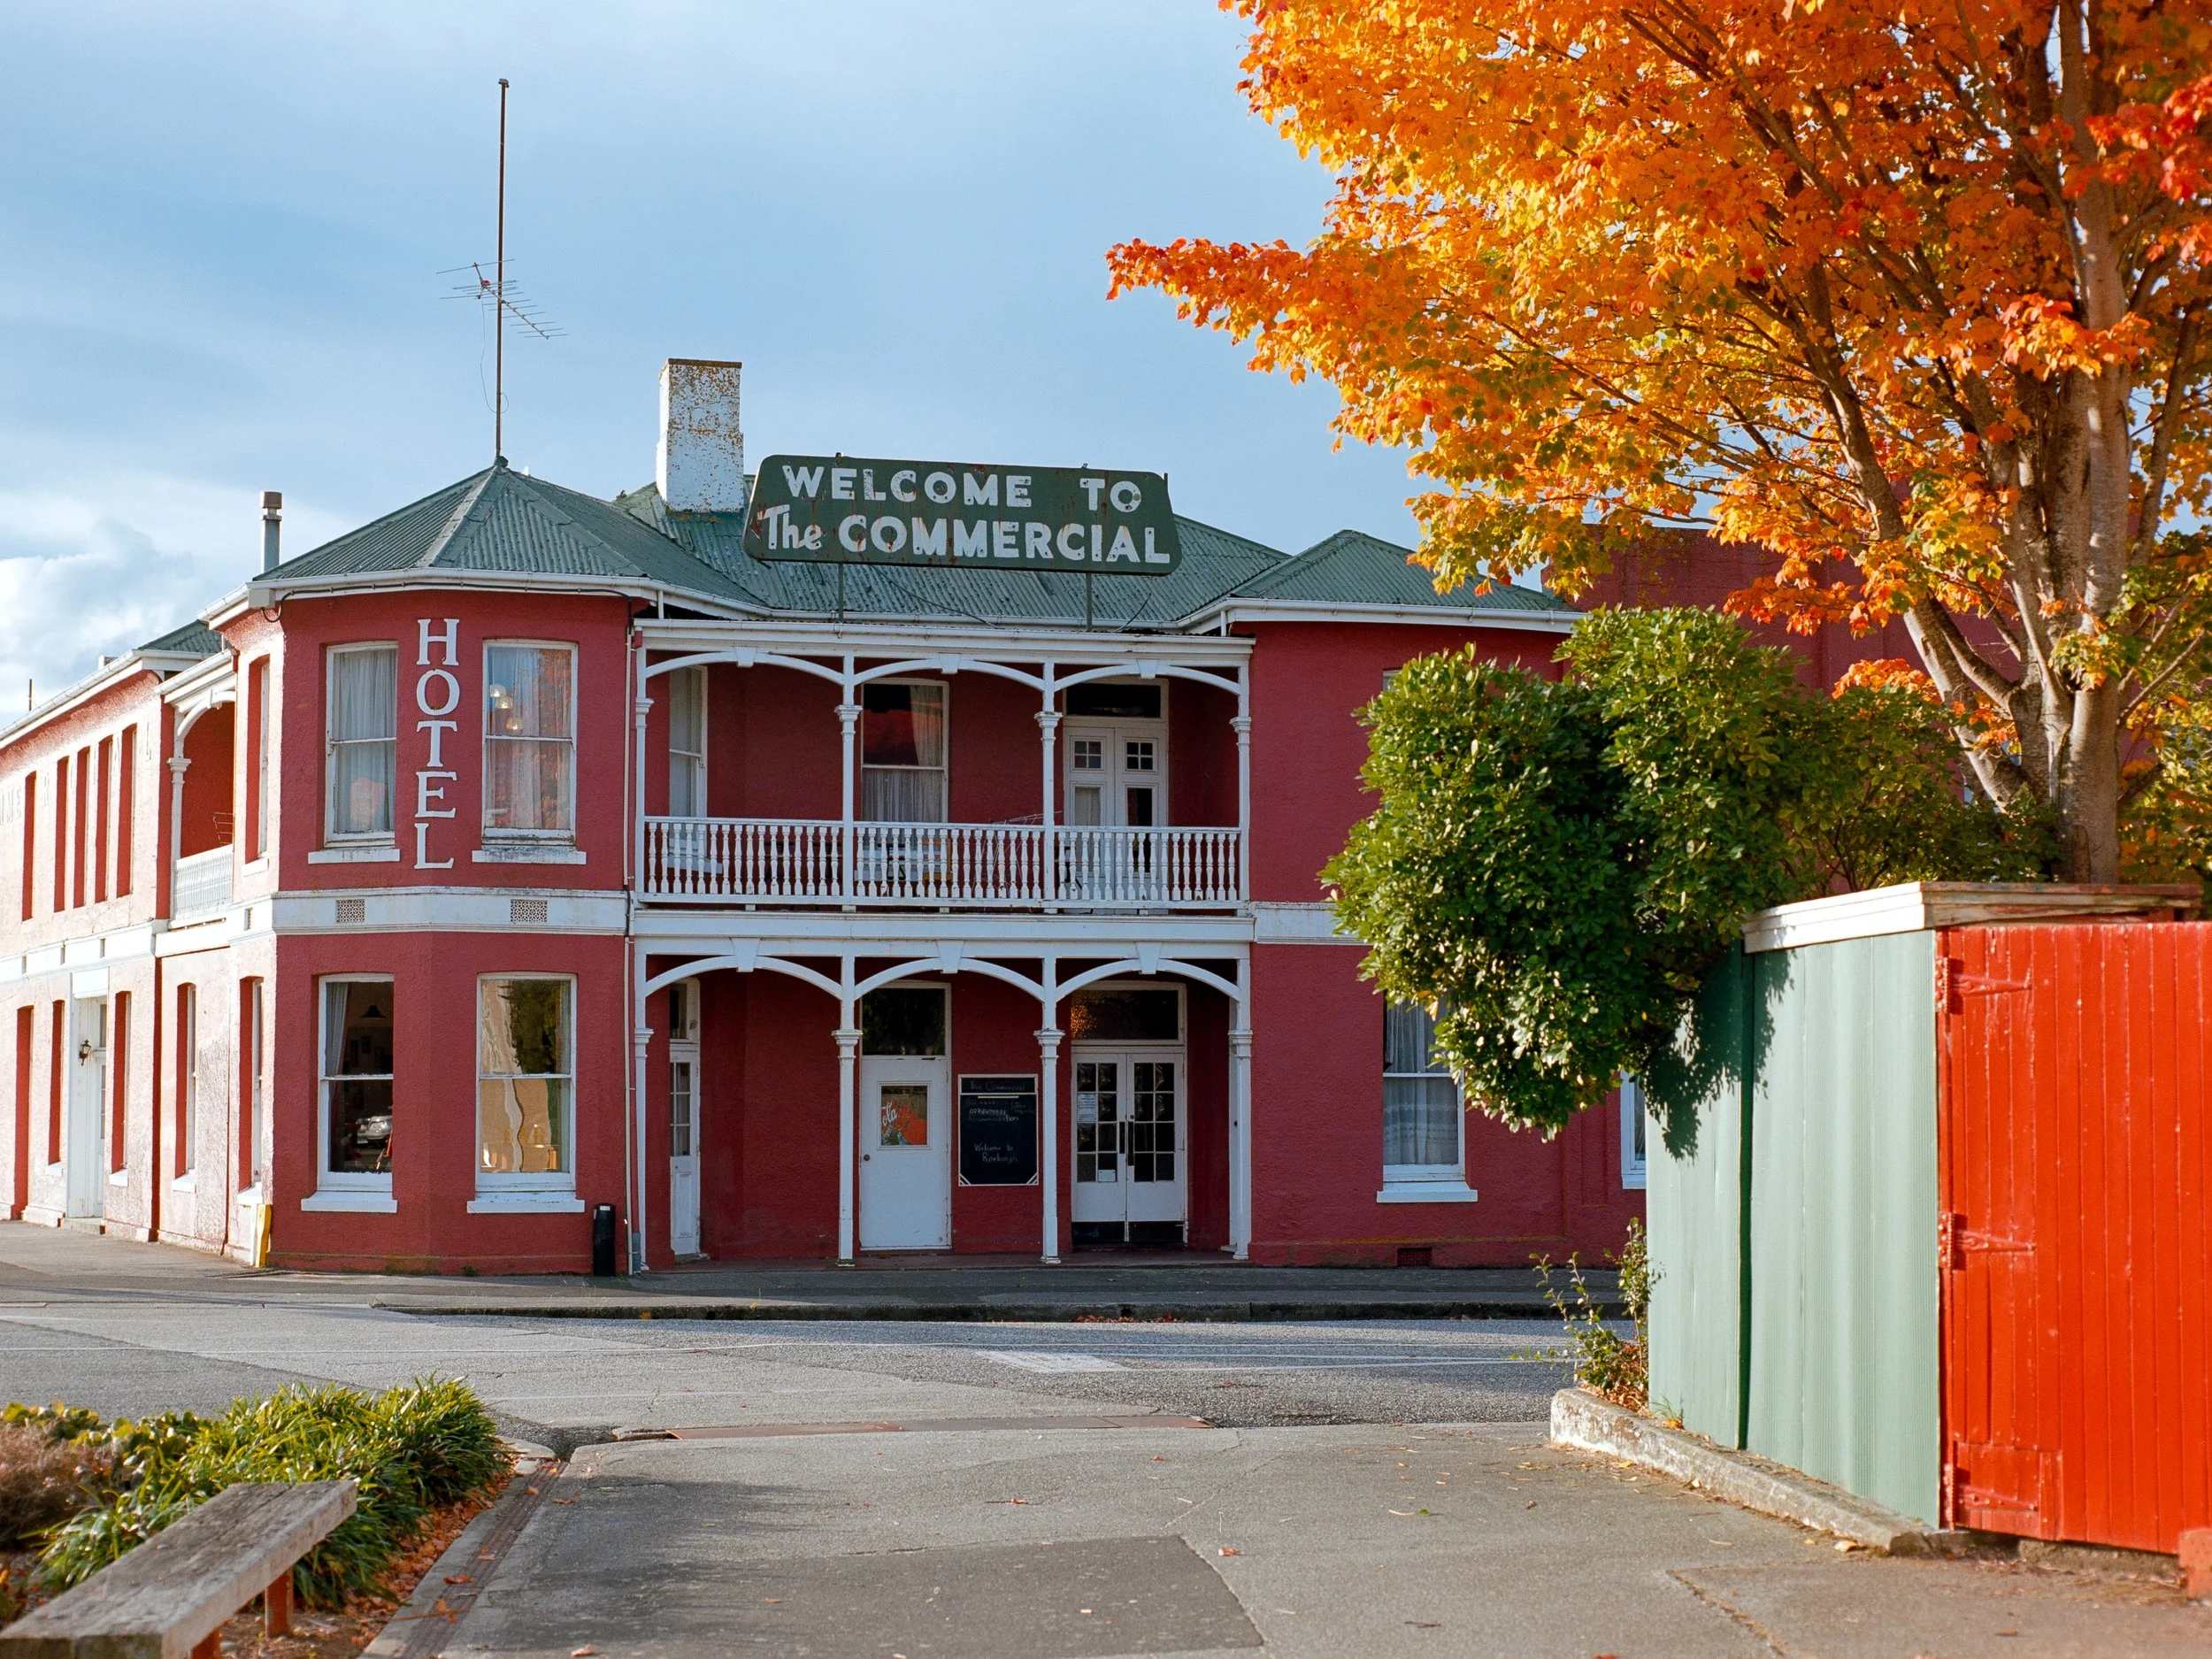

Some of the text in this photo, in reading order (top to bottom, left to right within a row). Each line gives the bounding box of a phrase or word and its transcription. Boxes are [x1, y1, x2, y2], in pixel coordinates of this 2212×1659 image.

[782, 465, 1142, 512] WELCOME TO
[757, 503, 1171, 564] The COMMERCIAL
[414, 618, 460, 869] HOTEL
